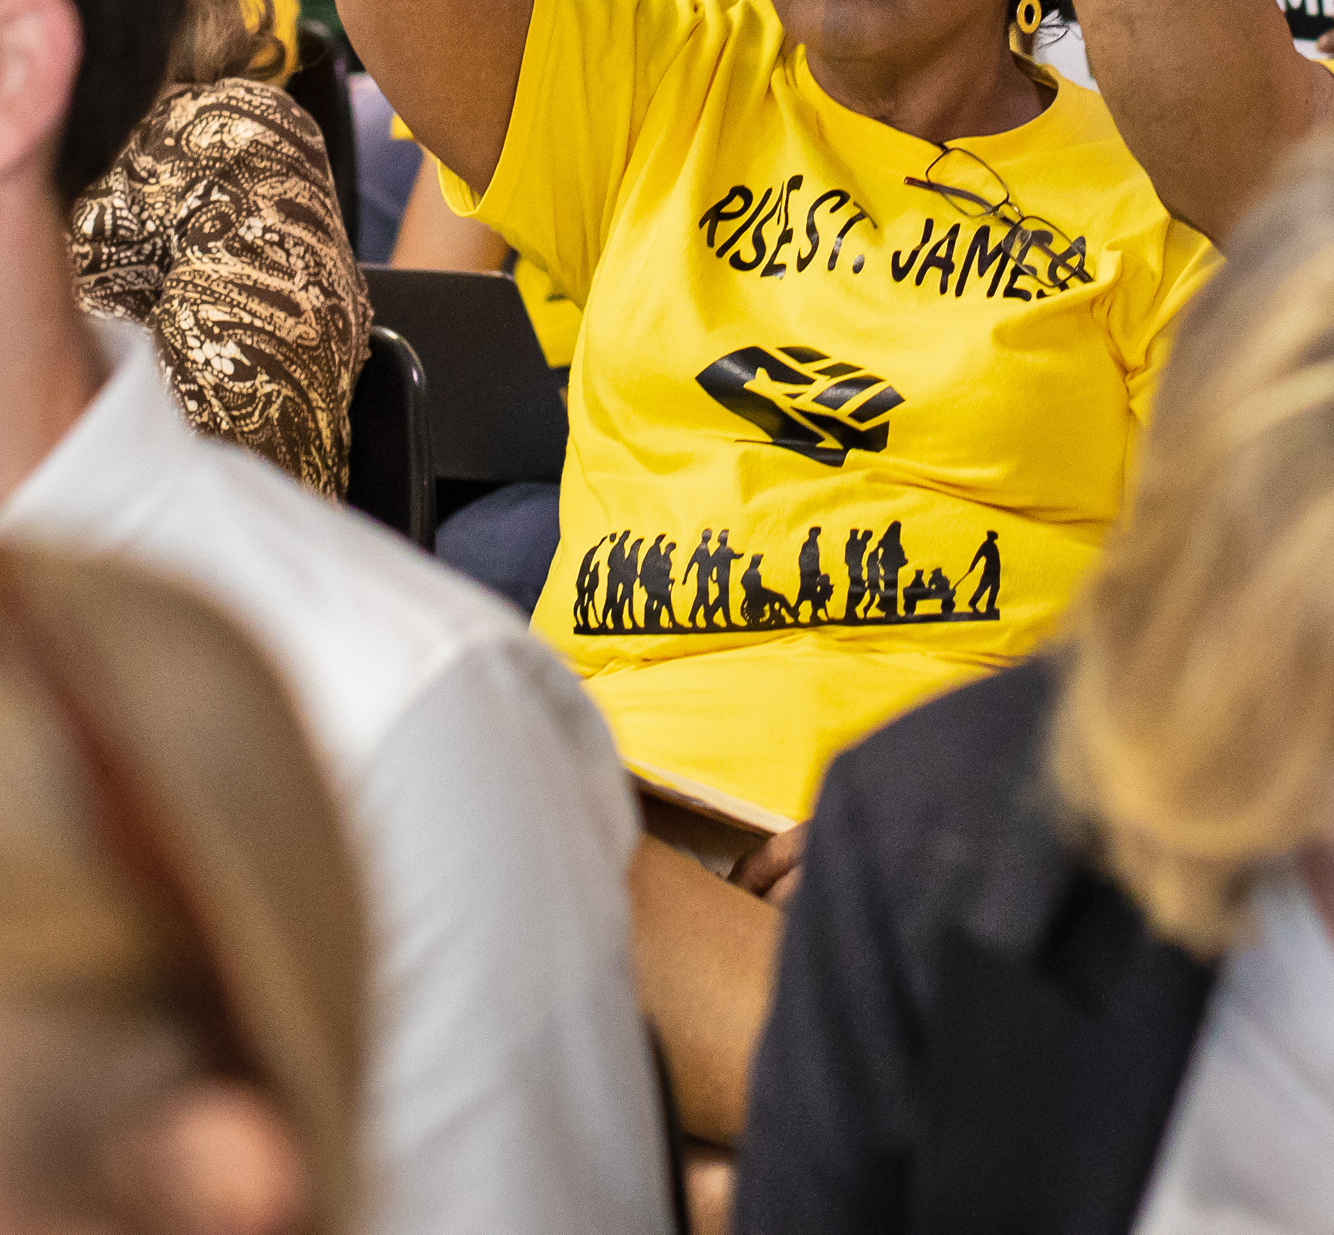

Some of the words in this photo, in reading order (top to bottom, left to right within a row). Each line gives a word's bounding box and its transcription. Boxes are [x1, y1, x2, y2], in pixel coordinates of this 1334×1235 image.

[699, 174, 804, 280] RISE
[796, 189, 878, 274] ST.
[891, 217, 1088, 302] JAMES
